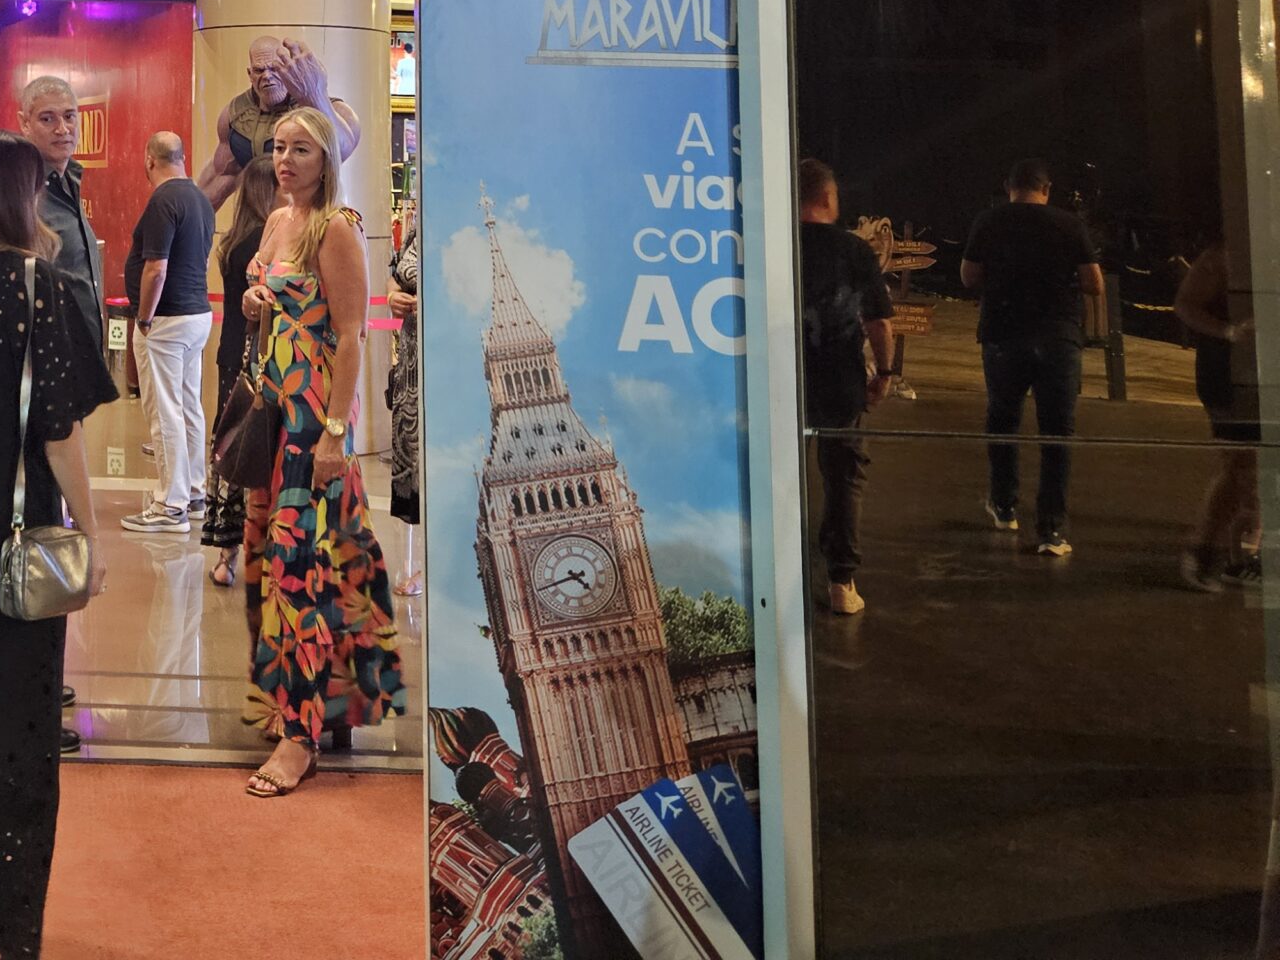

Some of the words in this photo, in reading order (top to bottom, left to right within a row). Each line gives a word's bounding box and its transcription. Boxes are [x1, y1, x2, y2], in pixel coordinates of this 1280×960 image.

[676, 112, 715, 157] A
[643, 160, 743, 216] via
[625, 805, 674, 864] AIRLINE
[666, 859, 712, 914] TICKET
